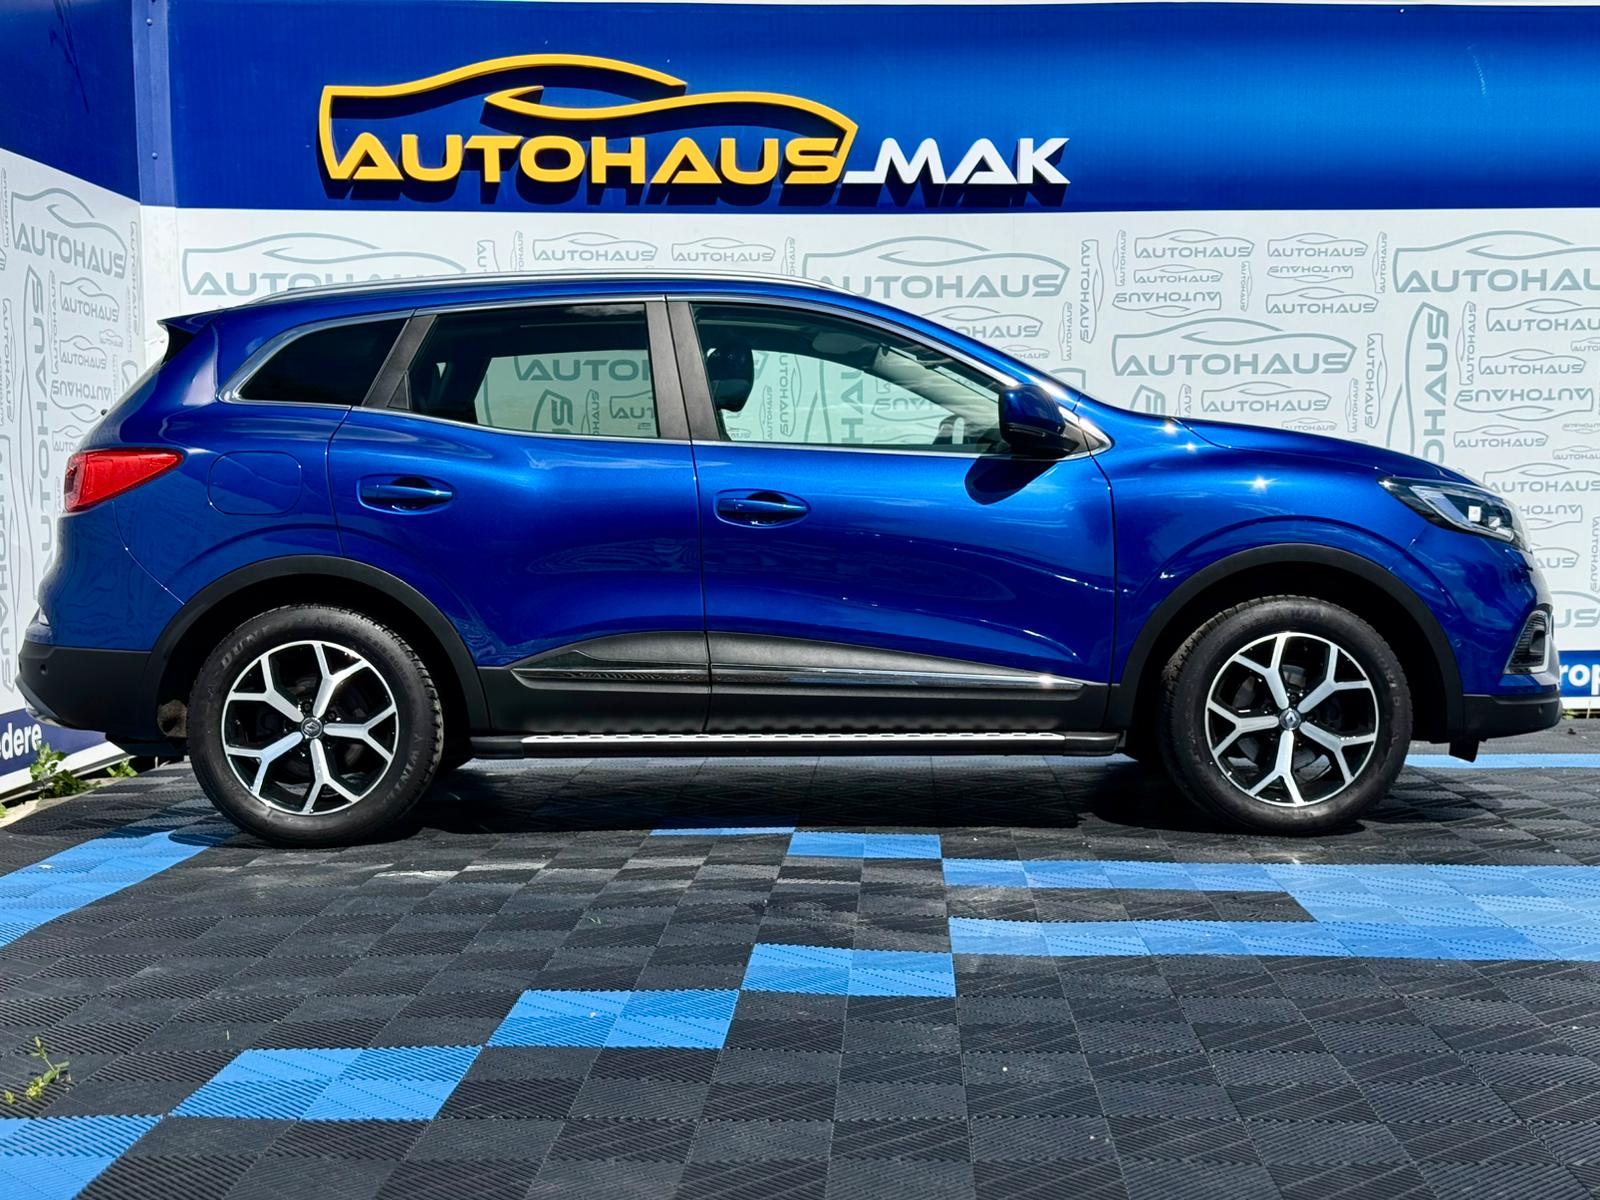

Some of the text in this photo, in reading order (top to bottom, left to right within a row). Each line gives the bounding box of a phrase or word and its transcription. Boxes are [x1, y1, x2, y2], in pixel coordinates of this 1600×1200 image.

[334, 132, 1070, 185] AUTOHAUS MAK
[15, 223, 127, 279] AUTOHAUS
[536, 249, 657, 261] AUTOHAUS
[673, 251, 773, 262] AUTOHAUS
[1137, 247, 1252, 258] AUTOHAUS
[1270, 247, 1366, 257] AUTOHAUS
[1136, 275, 1222, 283] AUTOHAUS
[1080, 241, 1091, 341] AUTOHAUS
[1115, 292, 1220, 302] AUTOHAUS
[61, 296, 119, 323] AUTOHAUS
[1270, 303, 1376, 314] AUTOHAUS
[1467, 304, 1476, 385] AUTOHAUS
[61, 352, 107, 370] AUTOHAUS
[1118, 353, 1354, 376] AUTOHAUS
[1484, 364, 1583, 374] AUTOHAUS
[1365, 335, 1376, 428] AUTOHAUS
[1424, 311, 1449, 463] OHAUS
[780, 355, 789, 436] UTOHAUS
[1459, 388, 1592, 402] AUTOHAUS
[1206, 399, 1329, 413] AUTOHAUS
[1456, 438, 1544, 447] AUTOHAUS
[0, 722, 43, 760] dere
